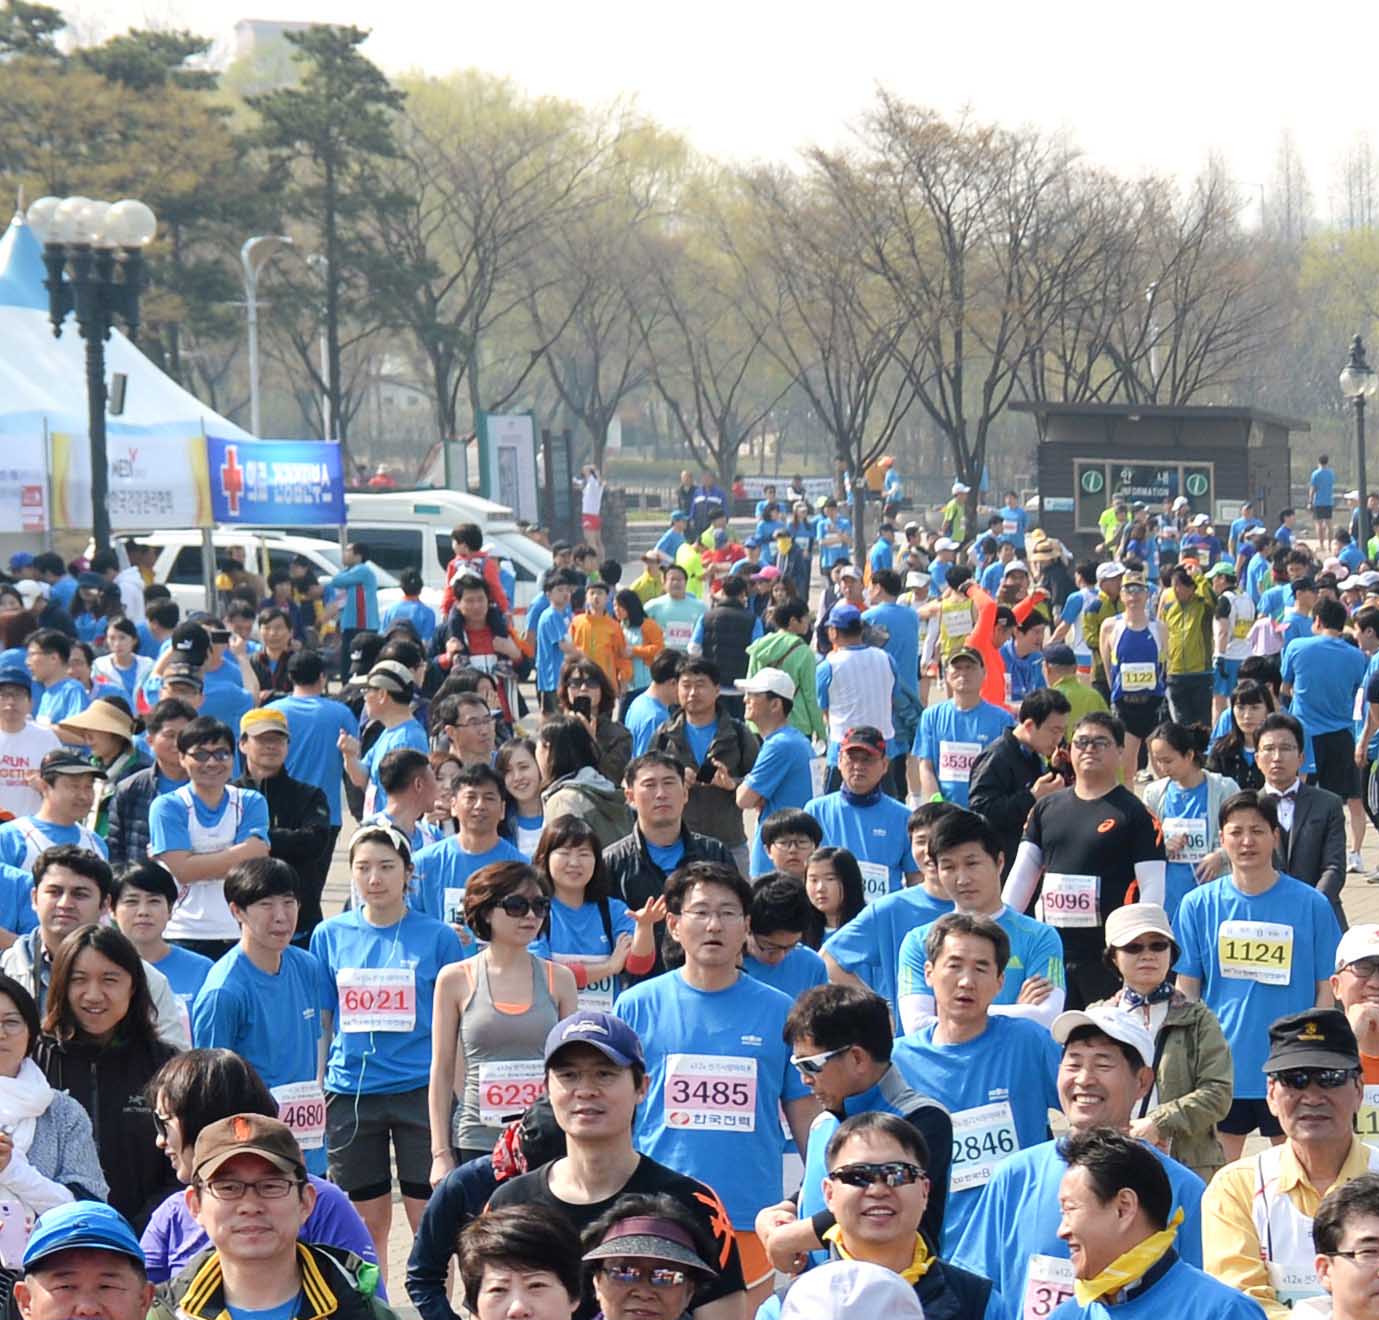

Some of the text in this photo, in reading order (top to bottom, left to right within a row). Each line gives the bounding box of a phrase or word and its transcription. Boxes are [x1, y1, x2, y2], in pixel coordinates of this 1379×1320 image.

[1120, 469, 1170, 486] 안내
[1125, 673, 1154, 684] 1122
[1046, 891, 1090, 910] 5096
[1226, 941, 1286, 964] 1124
[344, 989, 410, 1011] 6021
[671, 1078, 750, 1107] 3485
[283, 1102, 325, 1129] 4680
[692, 1111, 752, 1129] 한국전력
